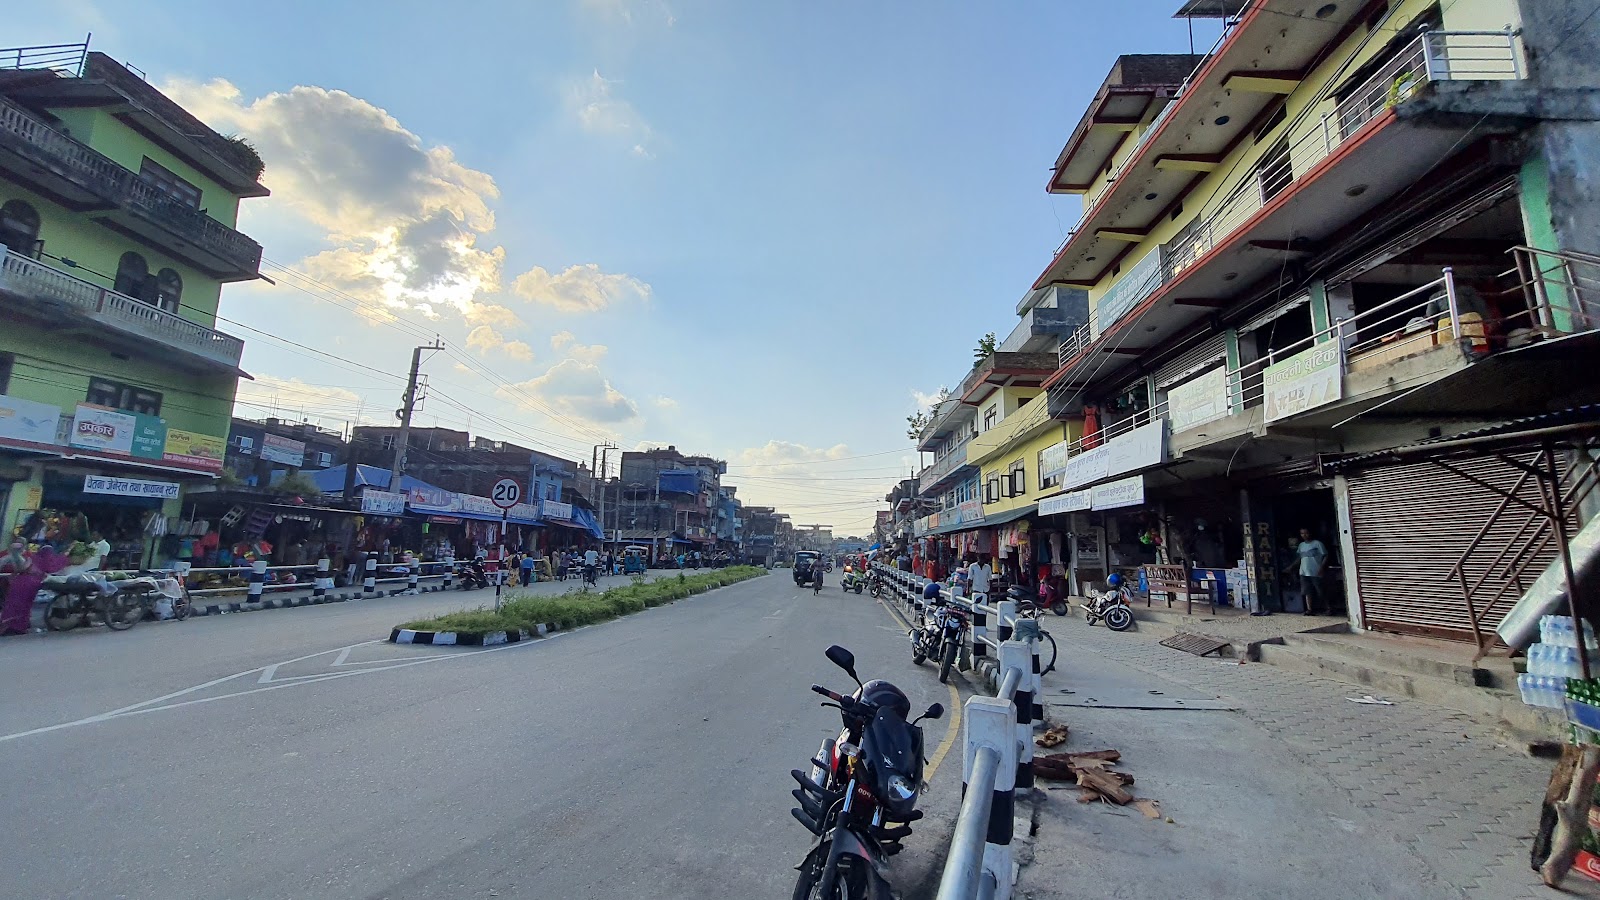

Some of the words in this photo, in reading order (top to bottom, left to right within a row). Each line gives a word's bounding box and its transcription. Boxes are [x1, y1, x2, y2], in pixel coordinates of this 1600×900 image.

[1304, 346, 1337, 374] बुटिक
[80, 421, 114, 436] उपकार
[129, 482, 142, 493] तथा
[165, 484, 178, 496] स्टोर
[494, 484, 518, 501] 20
[1243, 522, 1257, 594] RATHI
[1257, 522, 1276, 596] RATHI
